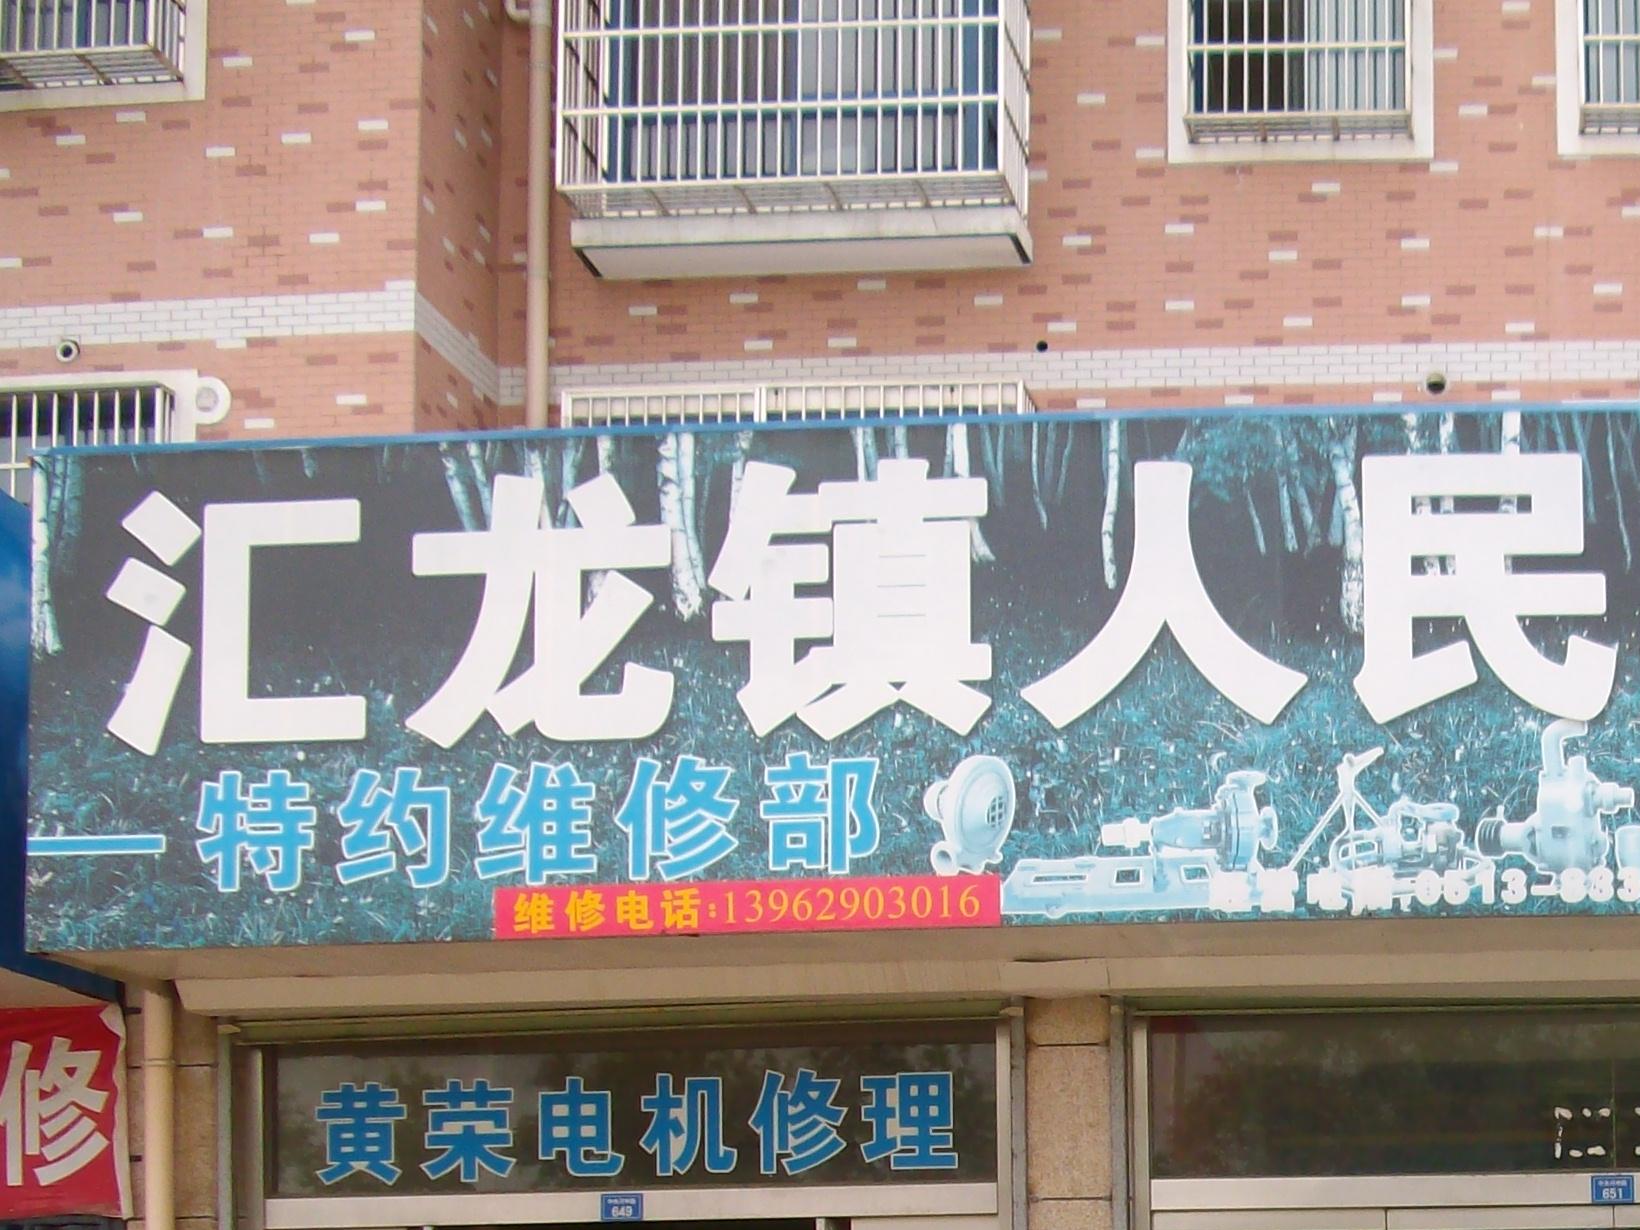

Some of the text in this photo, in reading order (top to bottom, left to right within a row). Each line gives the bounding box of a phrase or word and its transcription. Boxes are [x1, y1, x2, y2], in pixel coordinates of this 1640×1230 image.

[197, 750, 881, 893] 特约维修部
[315, 1067, 959, 1187] 黄荣电机修理
